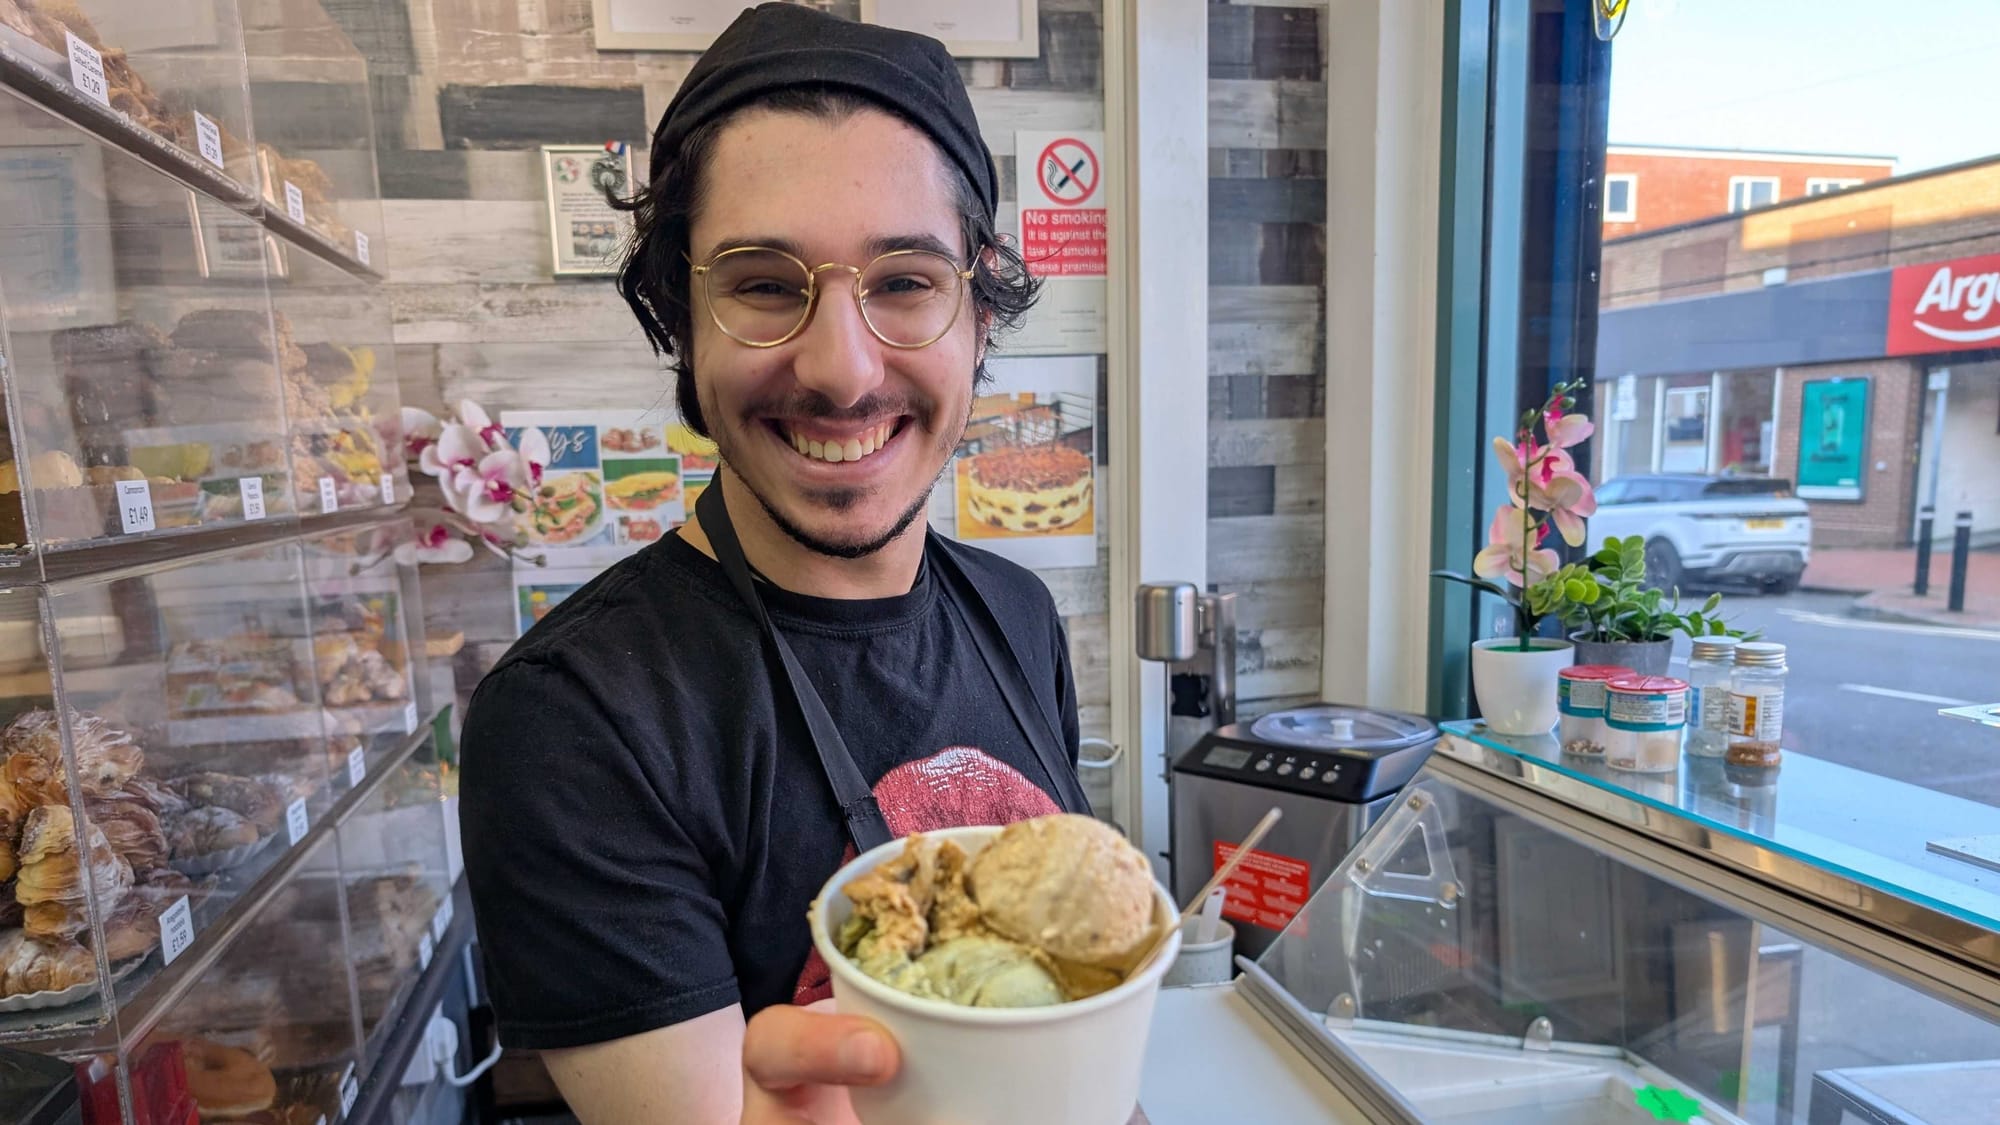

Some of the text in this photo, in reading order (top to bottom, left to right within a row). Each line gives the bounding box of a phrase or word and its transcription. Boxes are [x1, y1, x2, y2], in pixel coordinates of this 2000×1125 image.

[1025, 211, 1048, 225] No
[1028, 229, 1036, 241] It
[1037, 229, 1049, 241] is
[1050, 229, 1091, 244] against
[1026, 245, 1048, 257] law
[1048, 245, 1061, 257] to
[1061, 245, 1099, 257] smoke
[1029, 261, 1060, 273] these
[1914, 266, 2000, 322] Arg
